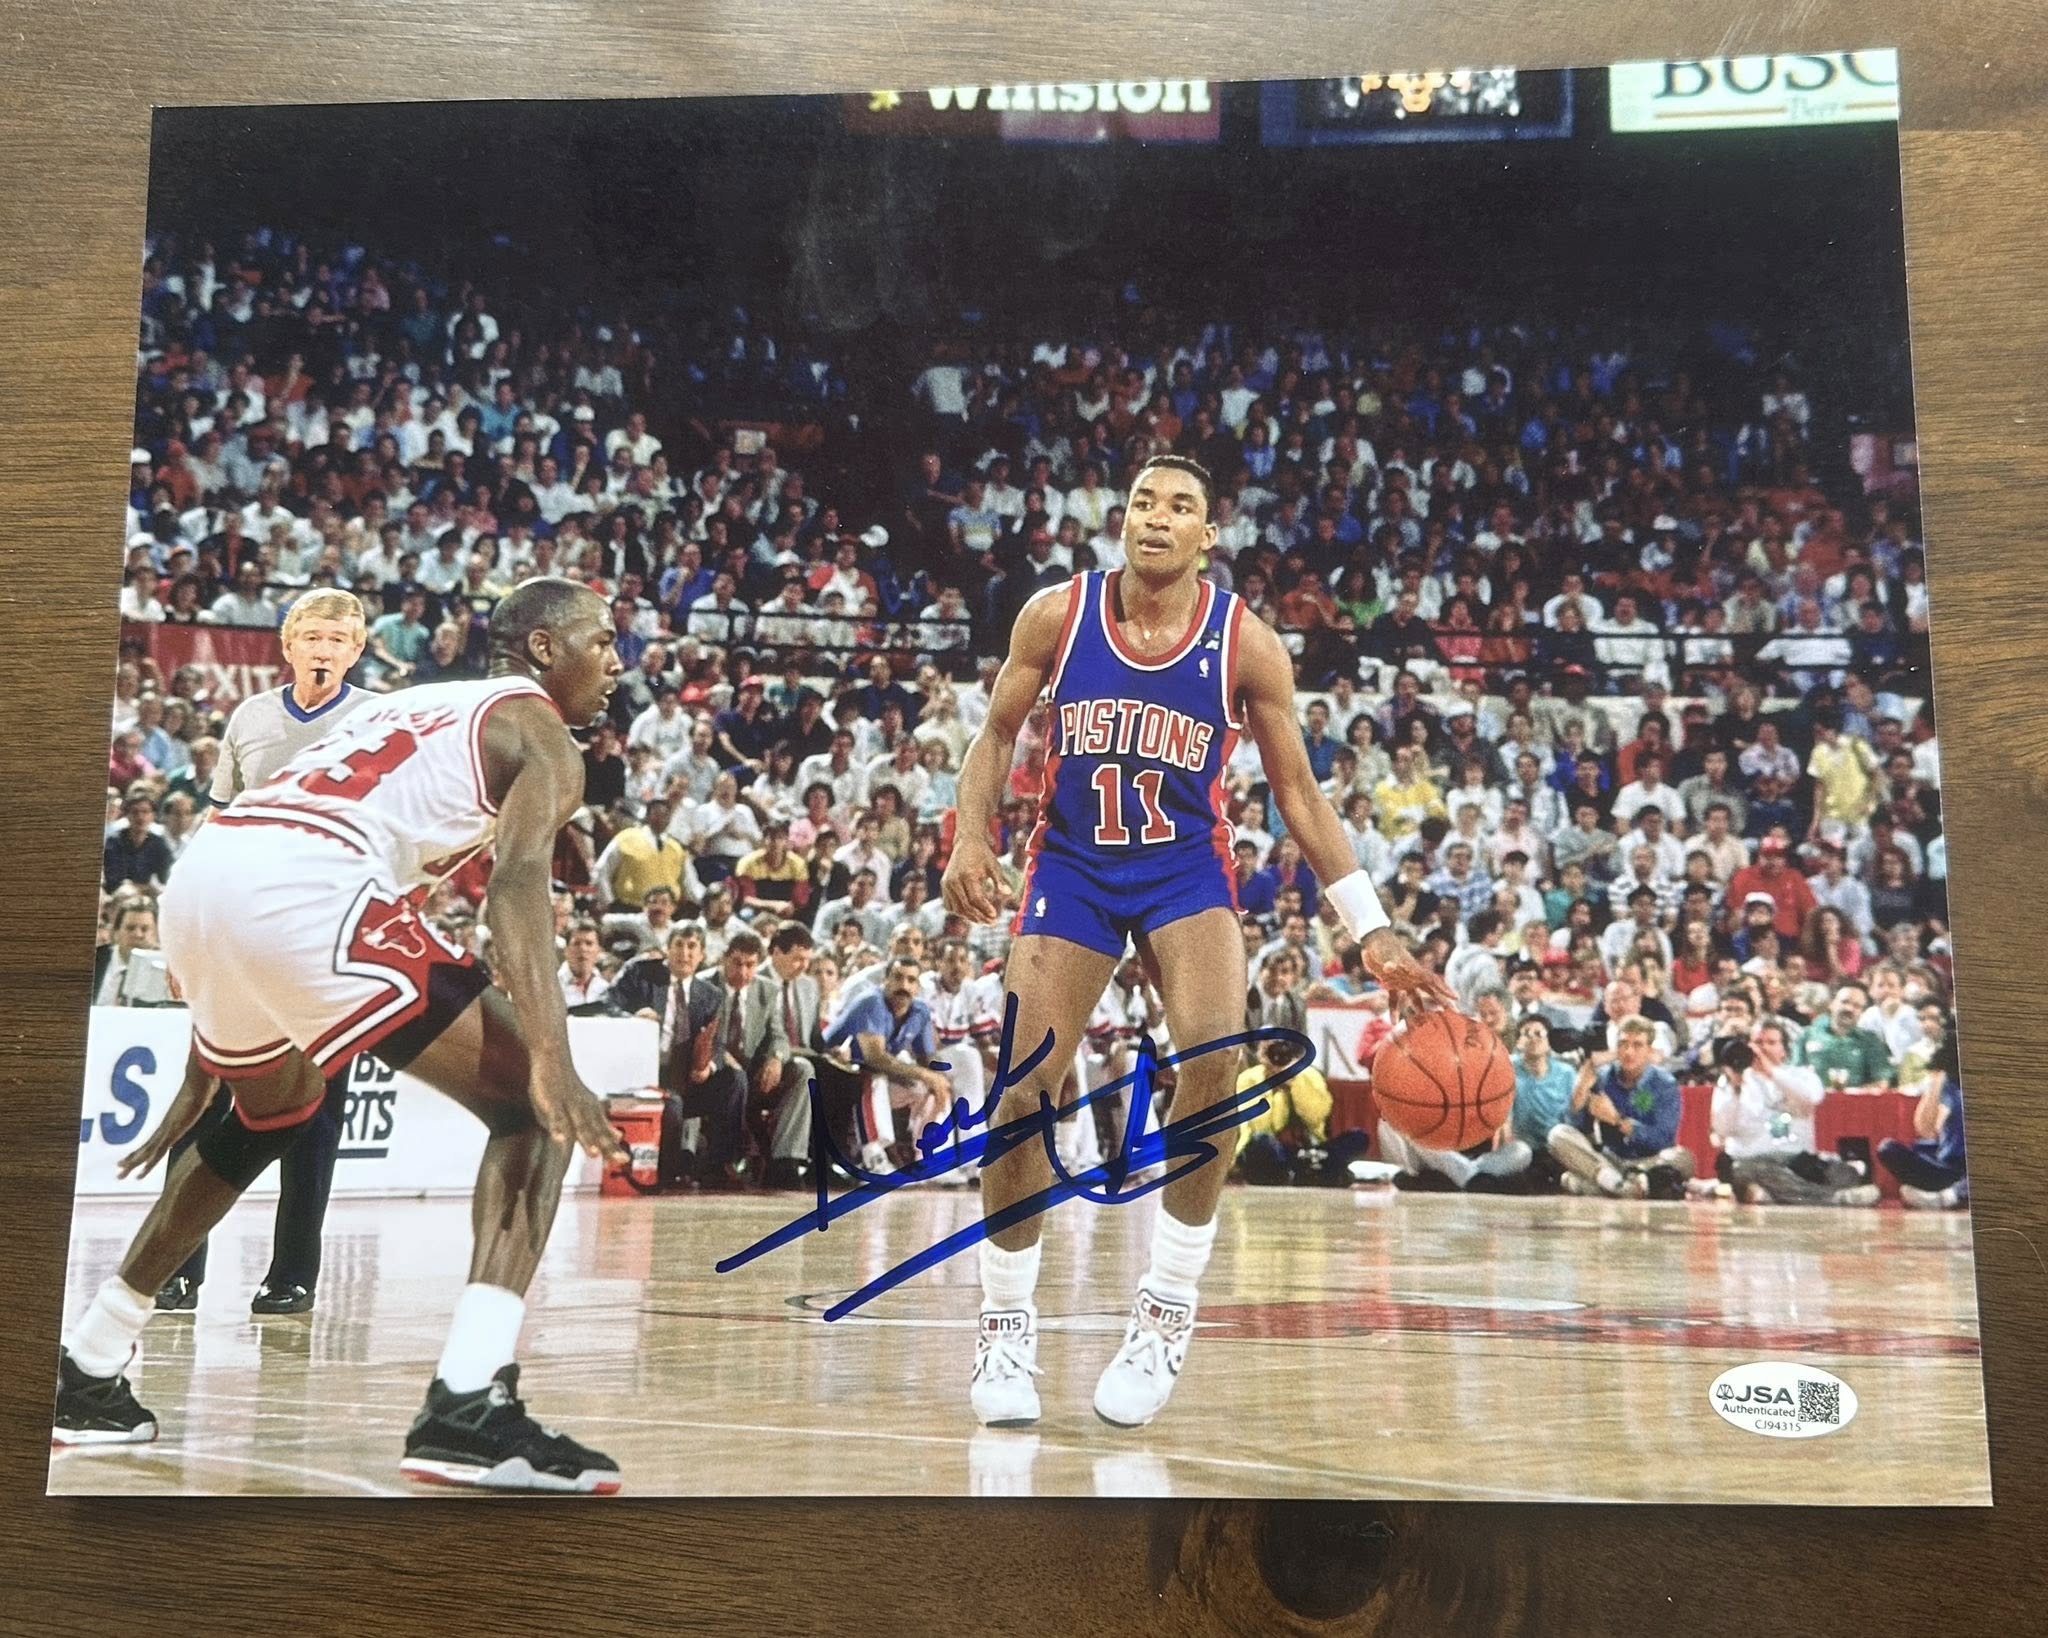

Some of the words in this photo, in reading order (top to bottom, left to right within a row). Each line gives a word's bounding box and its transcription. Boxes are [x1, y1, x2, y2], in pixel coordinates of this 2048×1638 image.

[1060, 699, 1214, 772] PISTONS
[1091, 763, 1176, 845] 11
[1735, 1385, 1794, 1405] JSA
[1722, 1403, 1796, 1418] Authenticated
[1755, 1420, 1802, 1432] CJ94315
